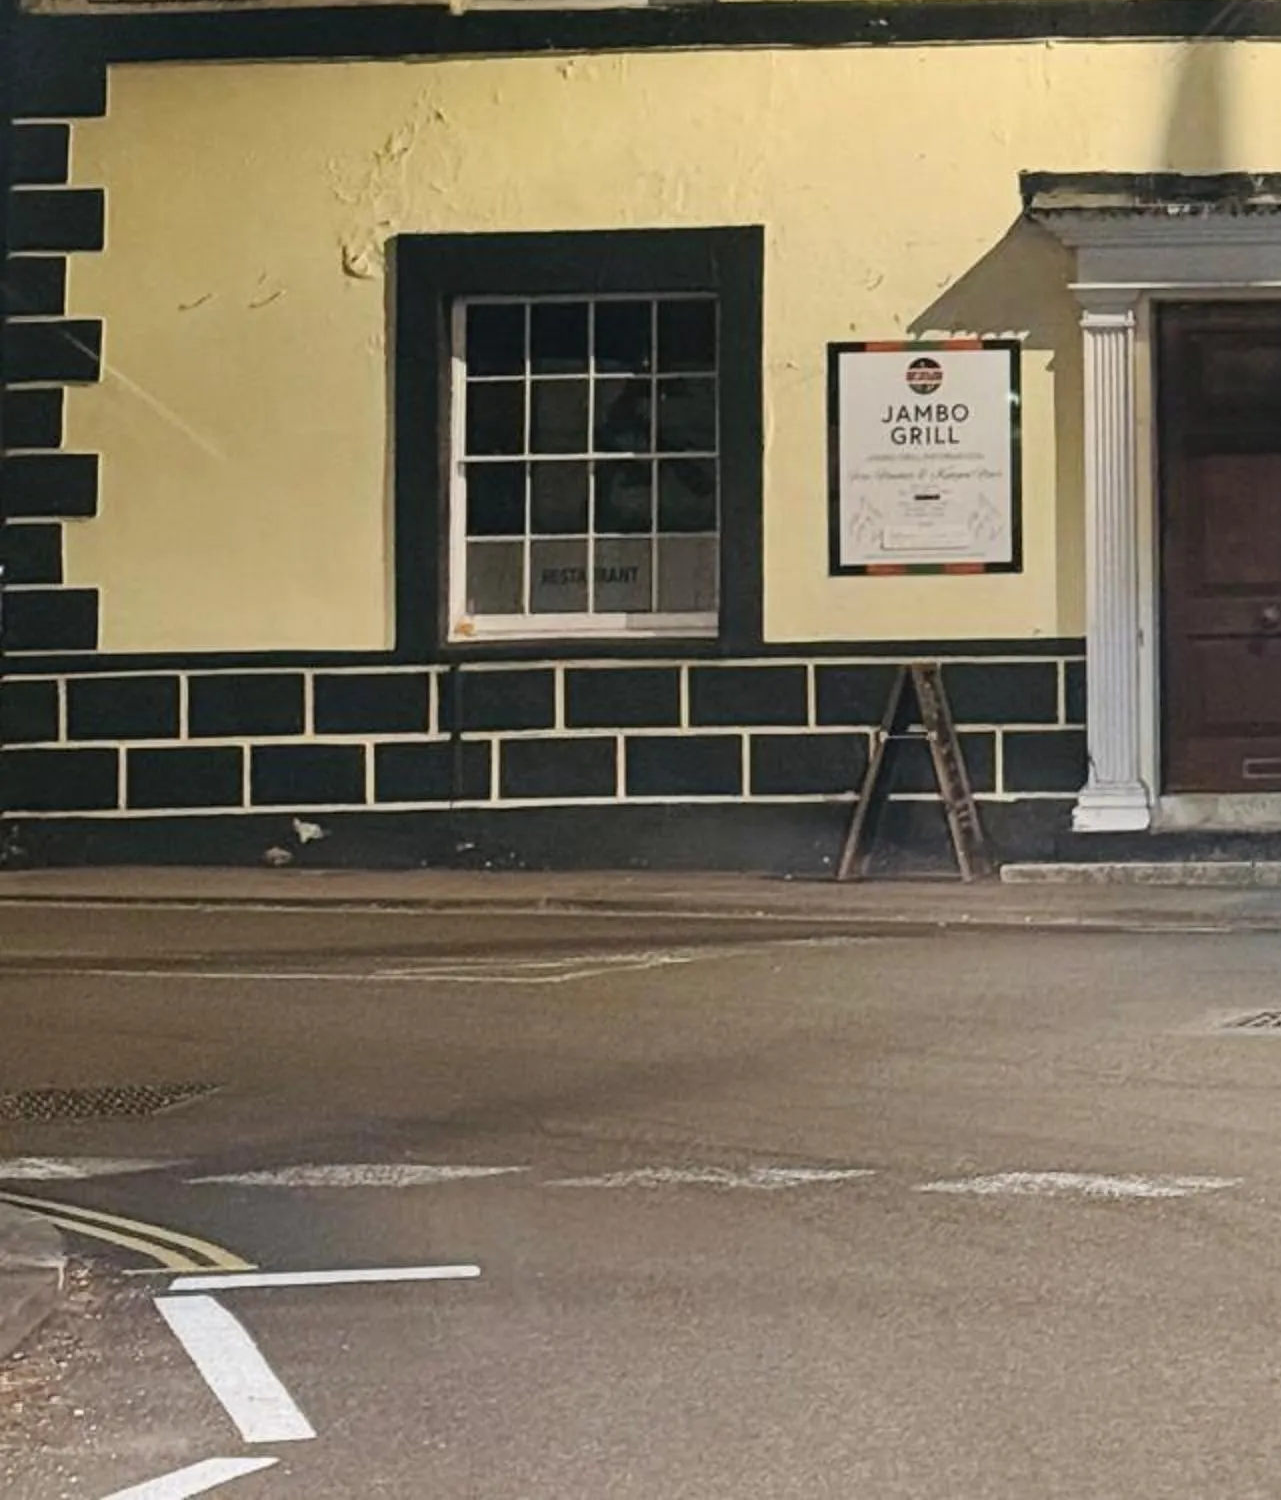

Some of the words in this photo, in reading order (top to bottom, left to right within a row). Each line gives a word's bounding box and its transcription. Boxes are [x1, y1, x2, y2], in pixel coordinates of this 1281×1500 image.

[881, 403, 970, 424] JAMBO
[890, 426, 961, 445] GRILL
[541, 566, 639, 586] RESTARANT
